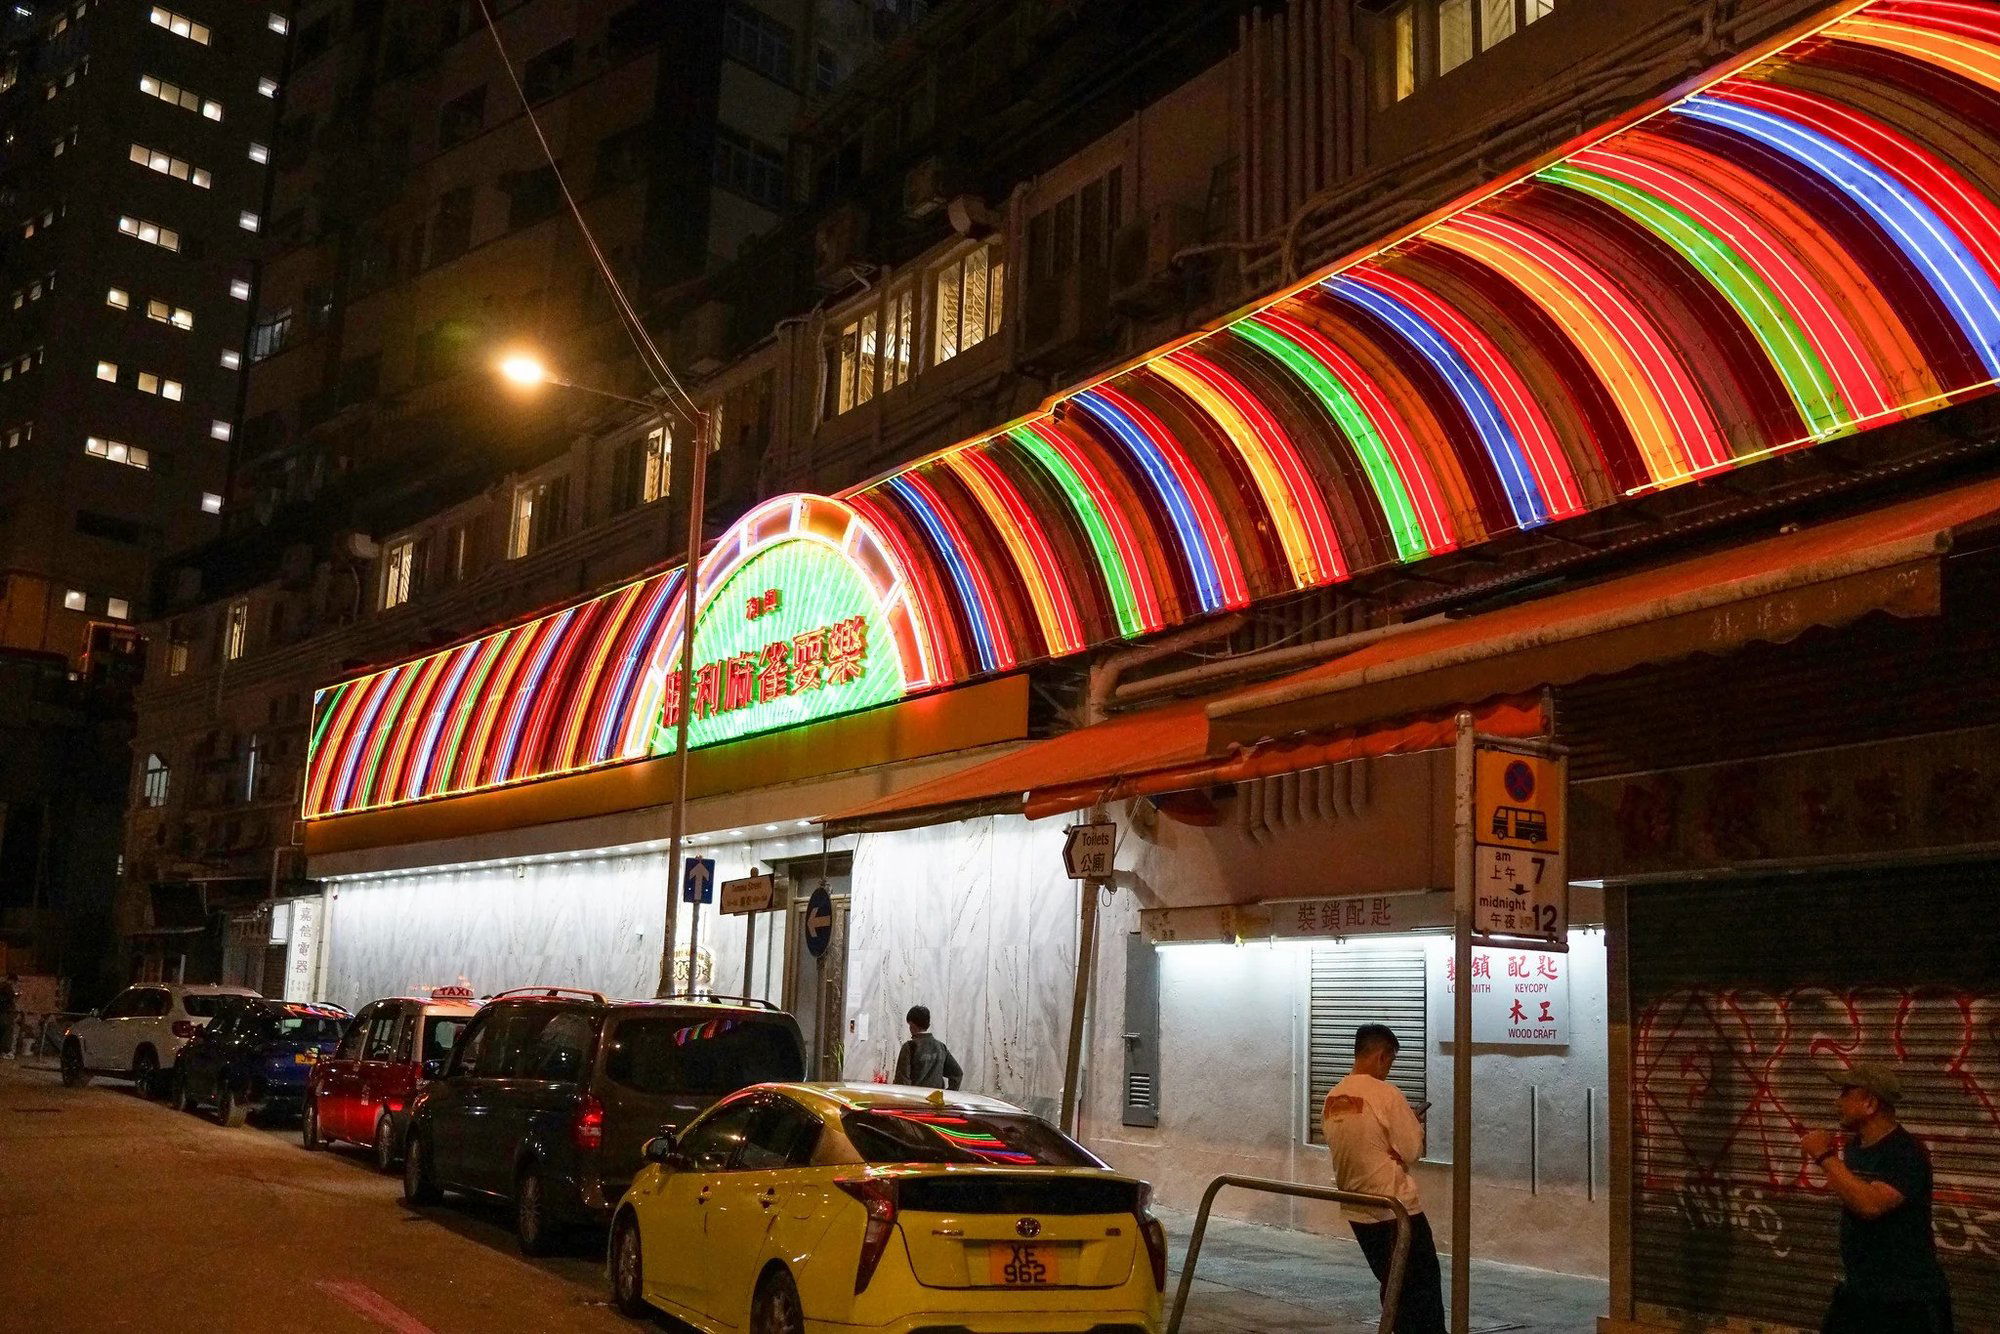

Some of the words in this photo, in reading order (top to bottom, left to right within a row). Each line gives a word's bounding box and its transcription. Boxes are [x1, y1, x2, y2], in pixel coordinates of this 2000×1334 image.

[1082, 832, 1110, 847] Toilets
[1495, 850, 1512, 862] am
[1490, 865, 1516, 882] 上午
[1531, 857, 1546, 885] 7
[1479, 895, 1527, 912] midnight
[1490, 912, 1516, 930] 午夜
[1531, 903, 1558, 933] 12
[1508, 955, 1559, 981] 配匙
[441, 987, 470, 997] TAXI
[1515, 983, 1549, 993] KEYCOPY
[1508, 998, 1555, 1025] 木工
[1508, 1028, 1532, 1039] WOOD
[1533, 1029, 1558, 1040] CRAFT
[1011, 1245, 1038, 1267] XE
[1004, 1263, 1046, 1284] 962
